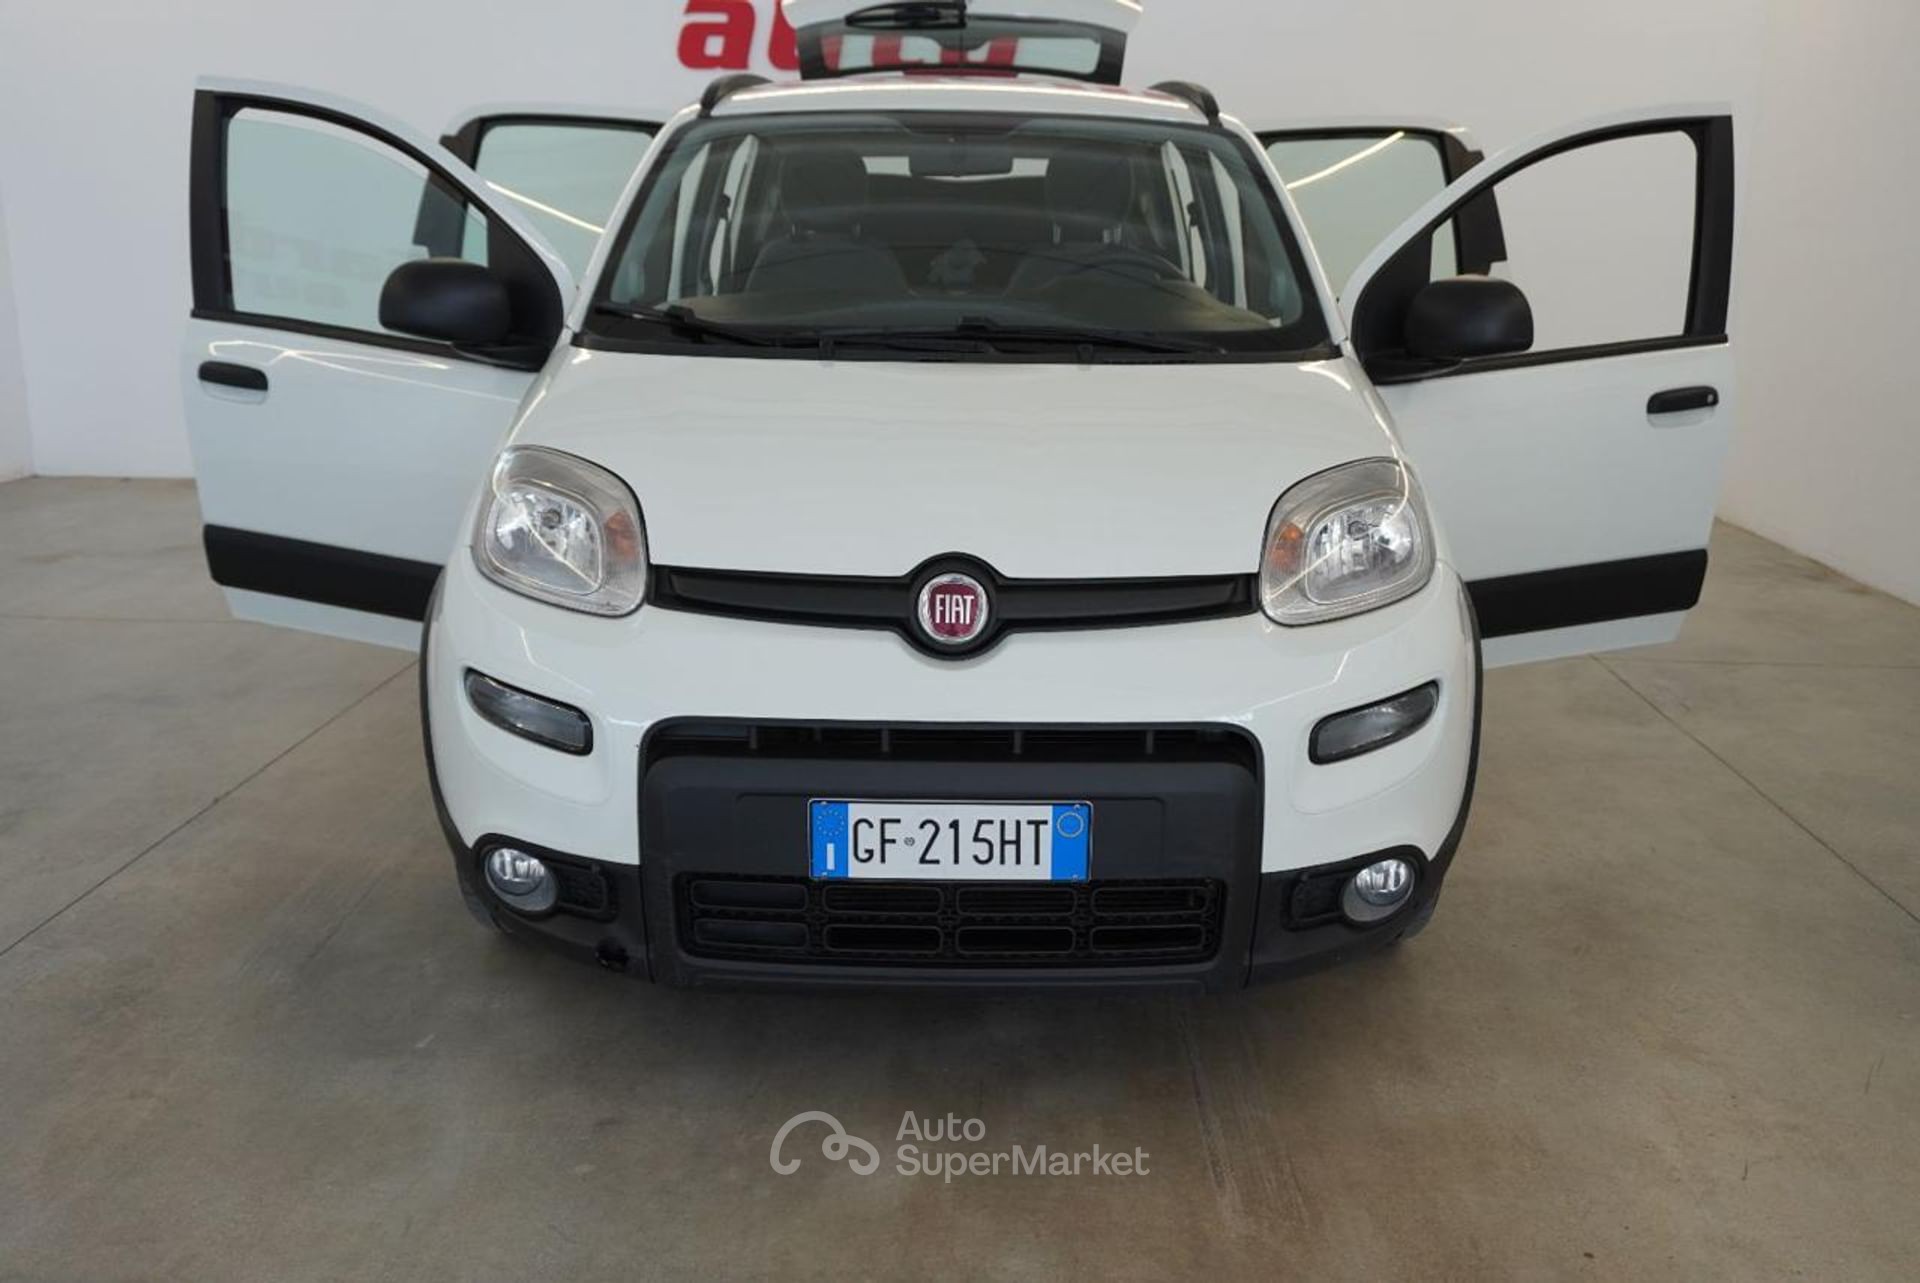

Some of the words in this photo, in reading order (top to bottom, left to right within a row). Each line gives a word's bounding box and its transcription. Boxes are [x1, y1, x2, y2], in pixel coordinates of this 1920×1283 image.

[934, 594, 975, 625] FIAT
[852, 818, 901, 864] GF
[918, 819, 1048, 865] 215HT
